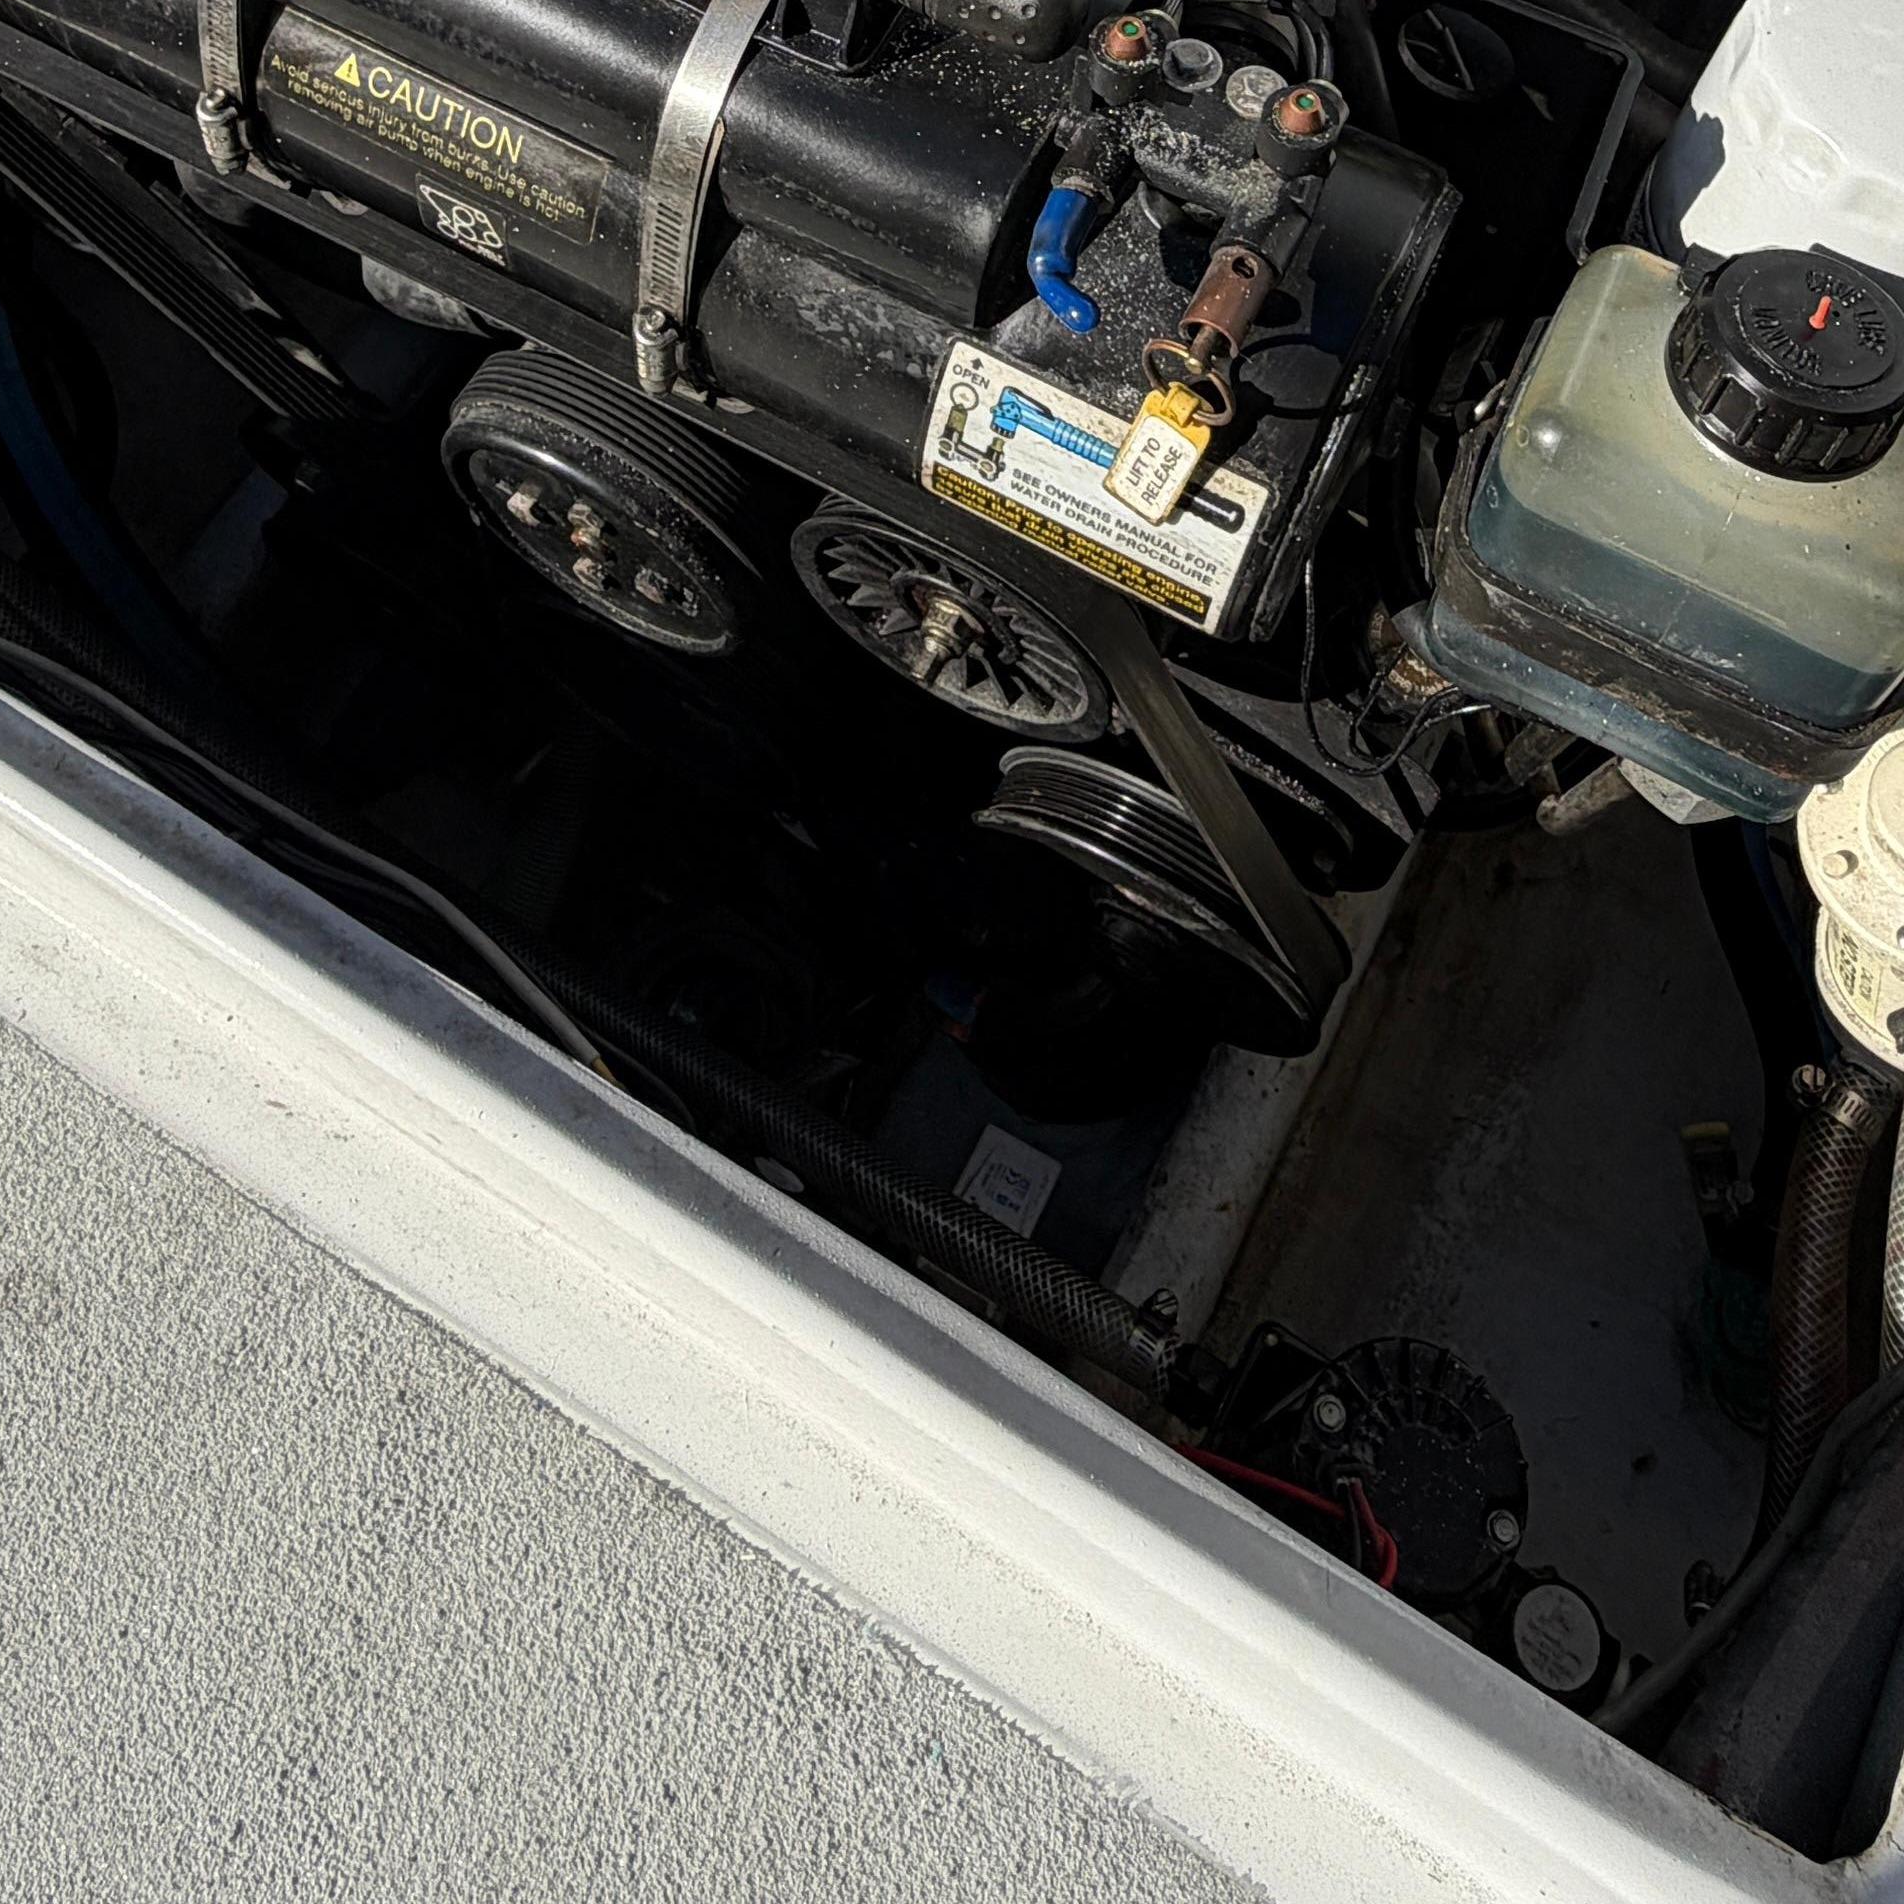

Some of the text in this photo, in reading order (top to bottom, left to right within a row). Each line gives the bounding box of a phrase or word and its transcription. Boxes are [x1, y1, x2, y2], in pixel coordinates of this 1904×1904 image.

[272, 54, 309, 83] Avoid
[311, 75, 365, 112] serious
[366, 100, 406, 134] injury
[409, 121, 445, 151] from
[495, 163, 527, 191] Use
[530, 180, 586, 219] caution
[286, 77, 353, 122] removing
[356, 111, 373, 128] air
[376, 122, 418, 153] pump
[421, 143, 462, 172] when
[463, 164, 514, 202] engine
[517, 191, 532, 208] is
[368, 62, 523, 166] CAUTION
[952, 363, 989, 390] OPEN
[1126, 437, 1161, 486] LIFT TO
[1141, 446, 1183, 506] RELEASE
[936, 463, 1001, 505] Caution:
[1004, 497, 1043, 525] Prior
[1045, 519, 1063, 535] to
[1065, 528, 1142, 577] operating
[990, 500, 1022, 524] that
[1025, 518, 1065, 546] drain
[1009, 478, 1212, 589] WATER DRAIN PROCEDURE
[1012, 465, 1217, 576] SEE OWNERS MANUAL FOR
